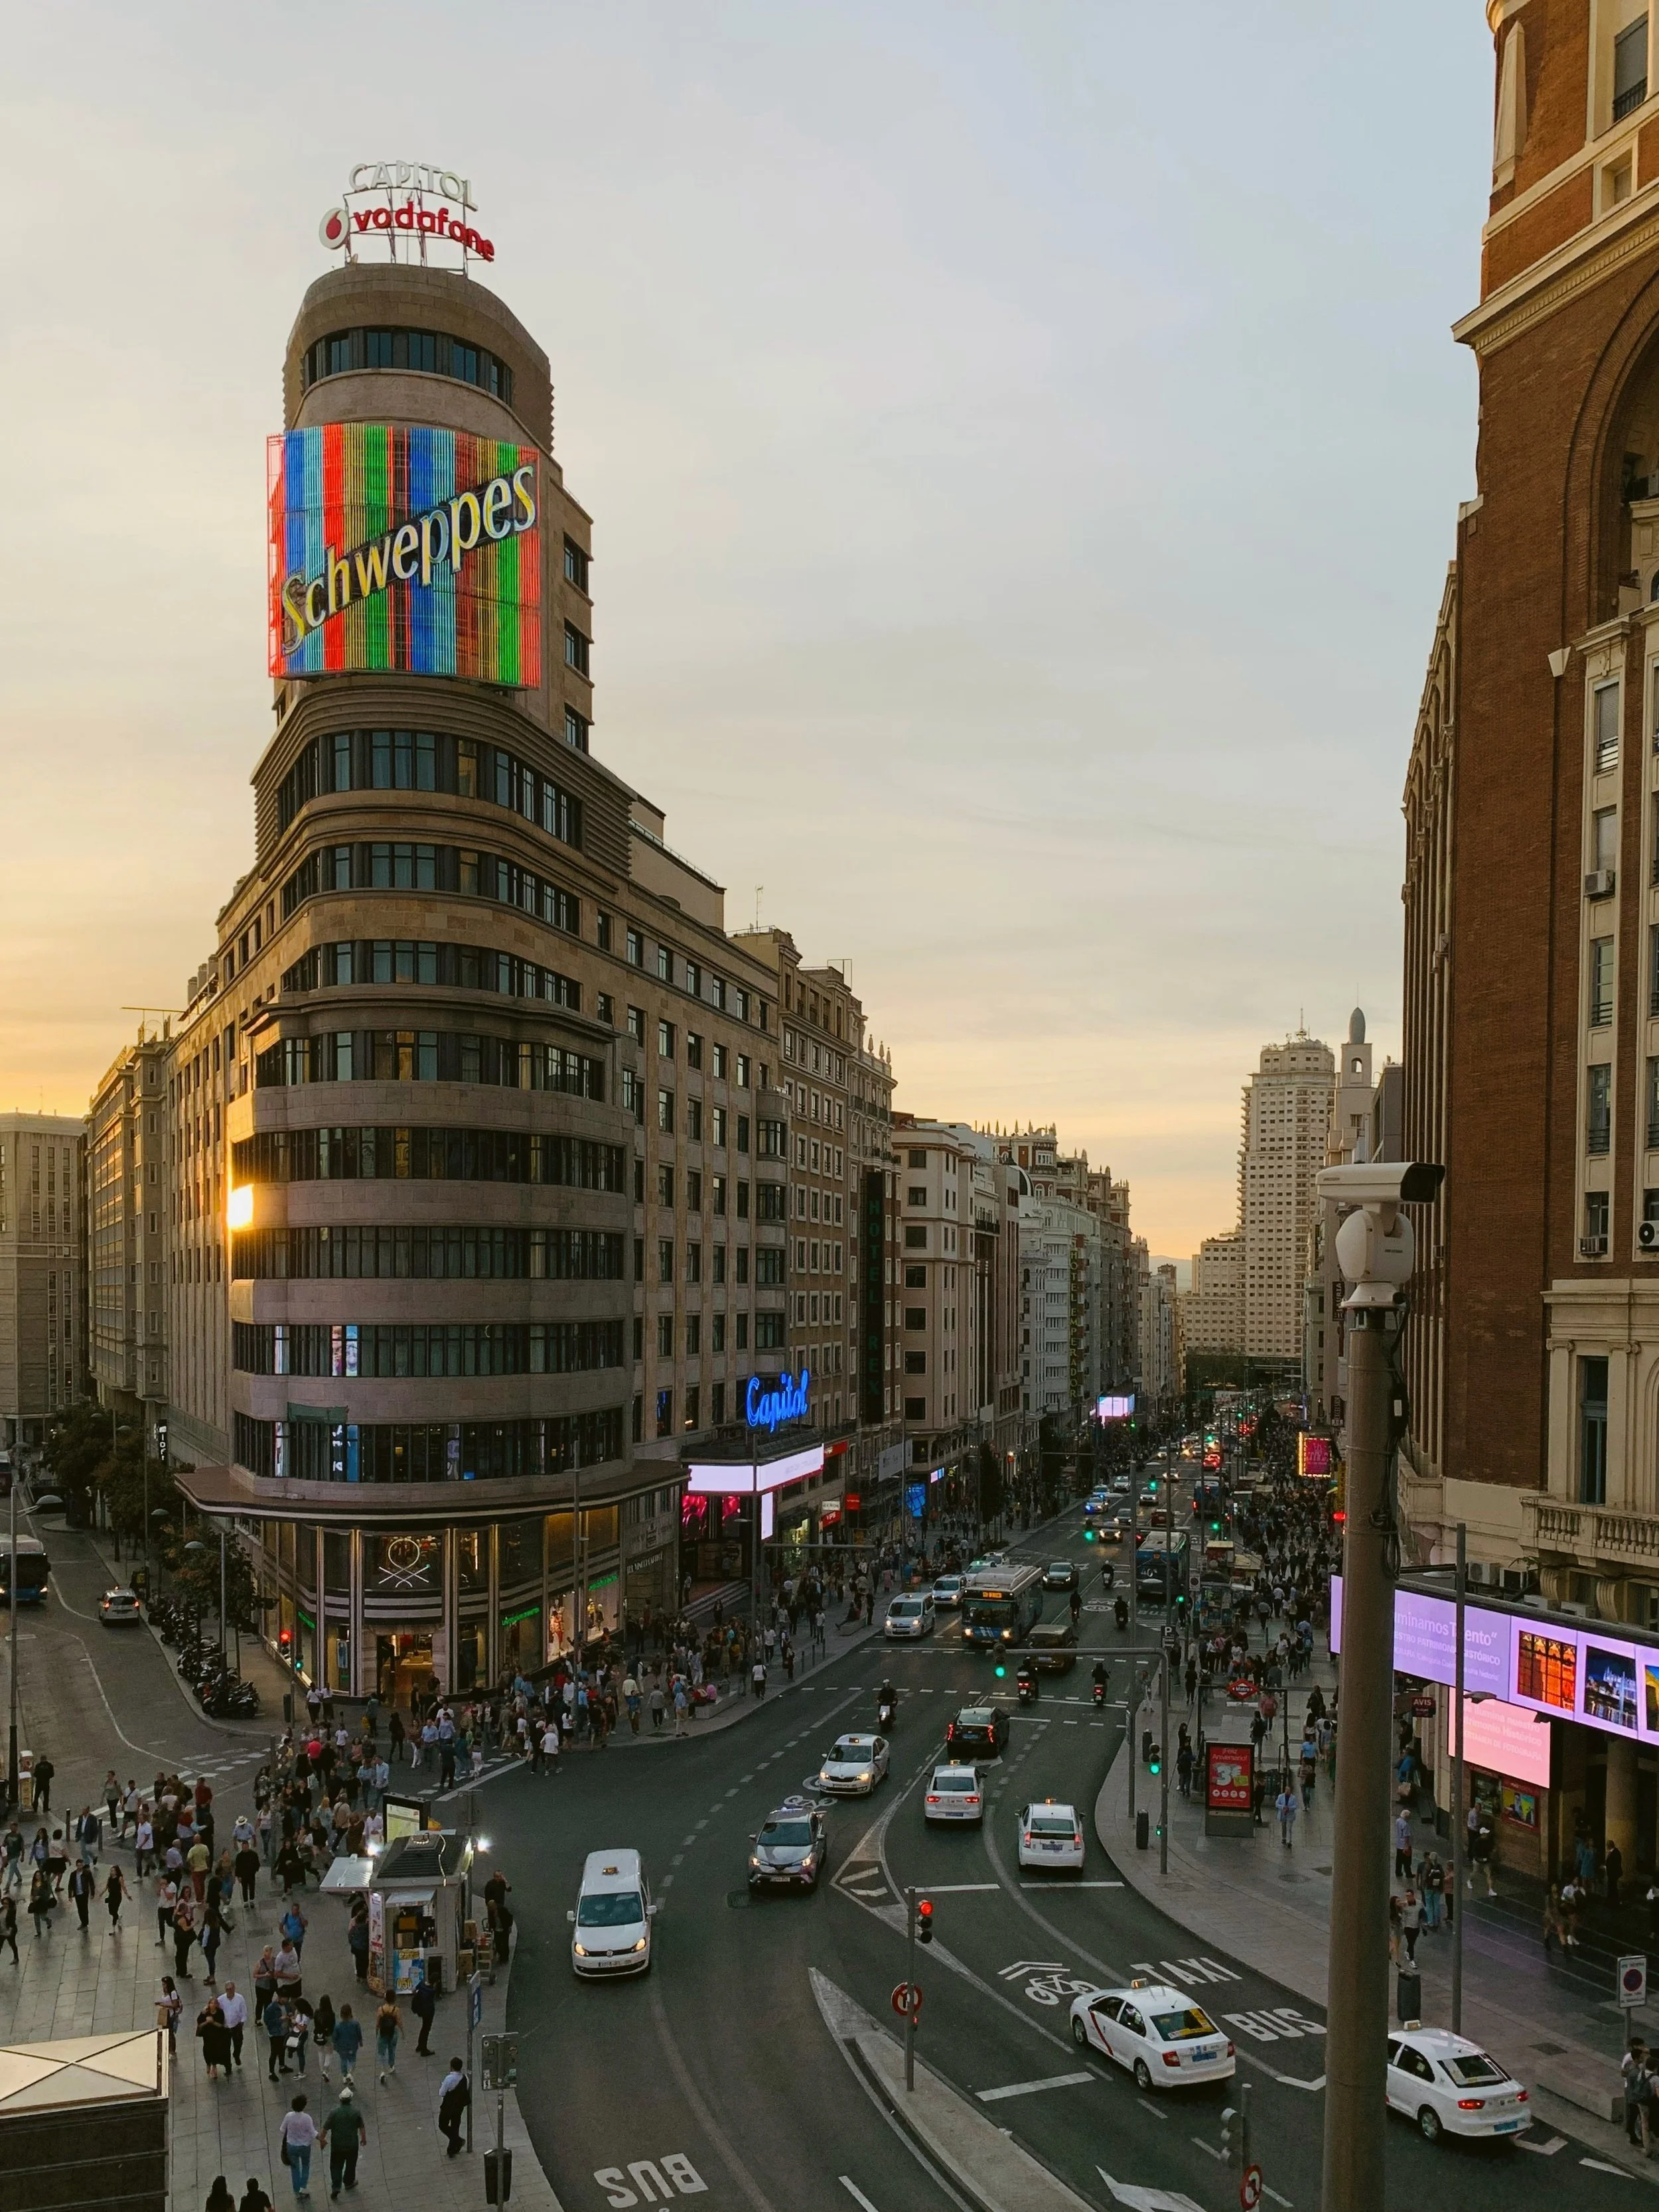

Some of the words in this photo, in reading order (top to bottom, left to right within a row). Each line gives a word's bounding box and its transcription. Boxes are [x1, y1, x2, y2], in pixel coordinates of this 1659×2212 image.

[348, 159, 478, 212] CAPITOL
[352, 200, 496, 263] vodafone
[281, 464, 538, 656] Schweppes
[867, 1198, 881, 1304] HOTEL
[1070, 1251, 1078, 1302] HOTEL
[867, 1334, 881, 1396] REX
[1069, 1307, 1078, 1399] EMPERADOR
[747, 1368, 809, 1434] Capitol
[1165, 1627, 1173, 1636] P
[1413, 1698, 1431, 1706] AVIS
[1130, 1957, 1243, 1987] TAXI
[1221, 2008, 1327, 2042] BUS
[593, 2152, 709, 2209] BUS
